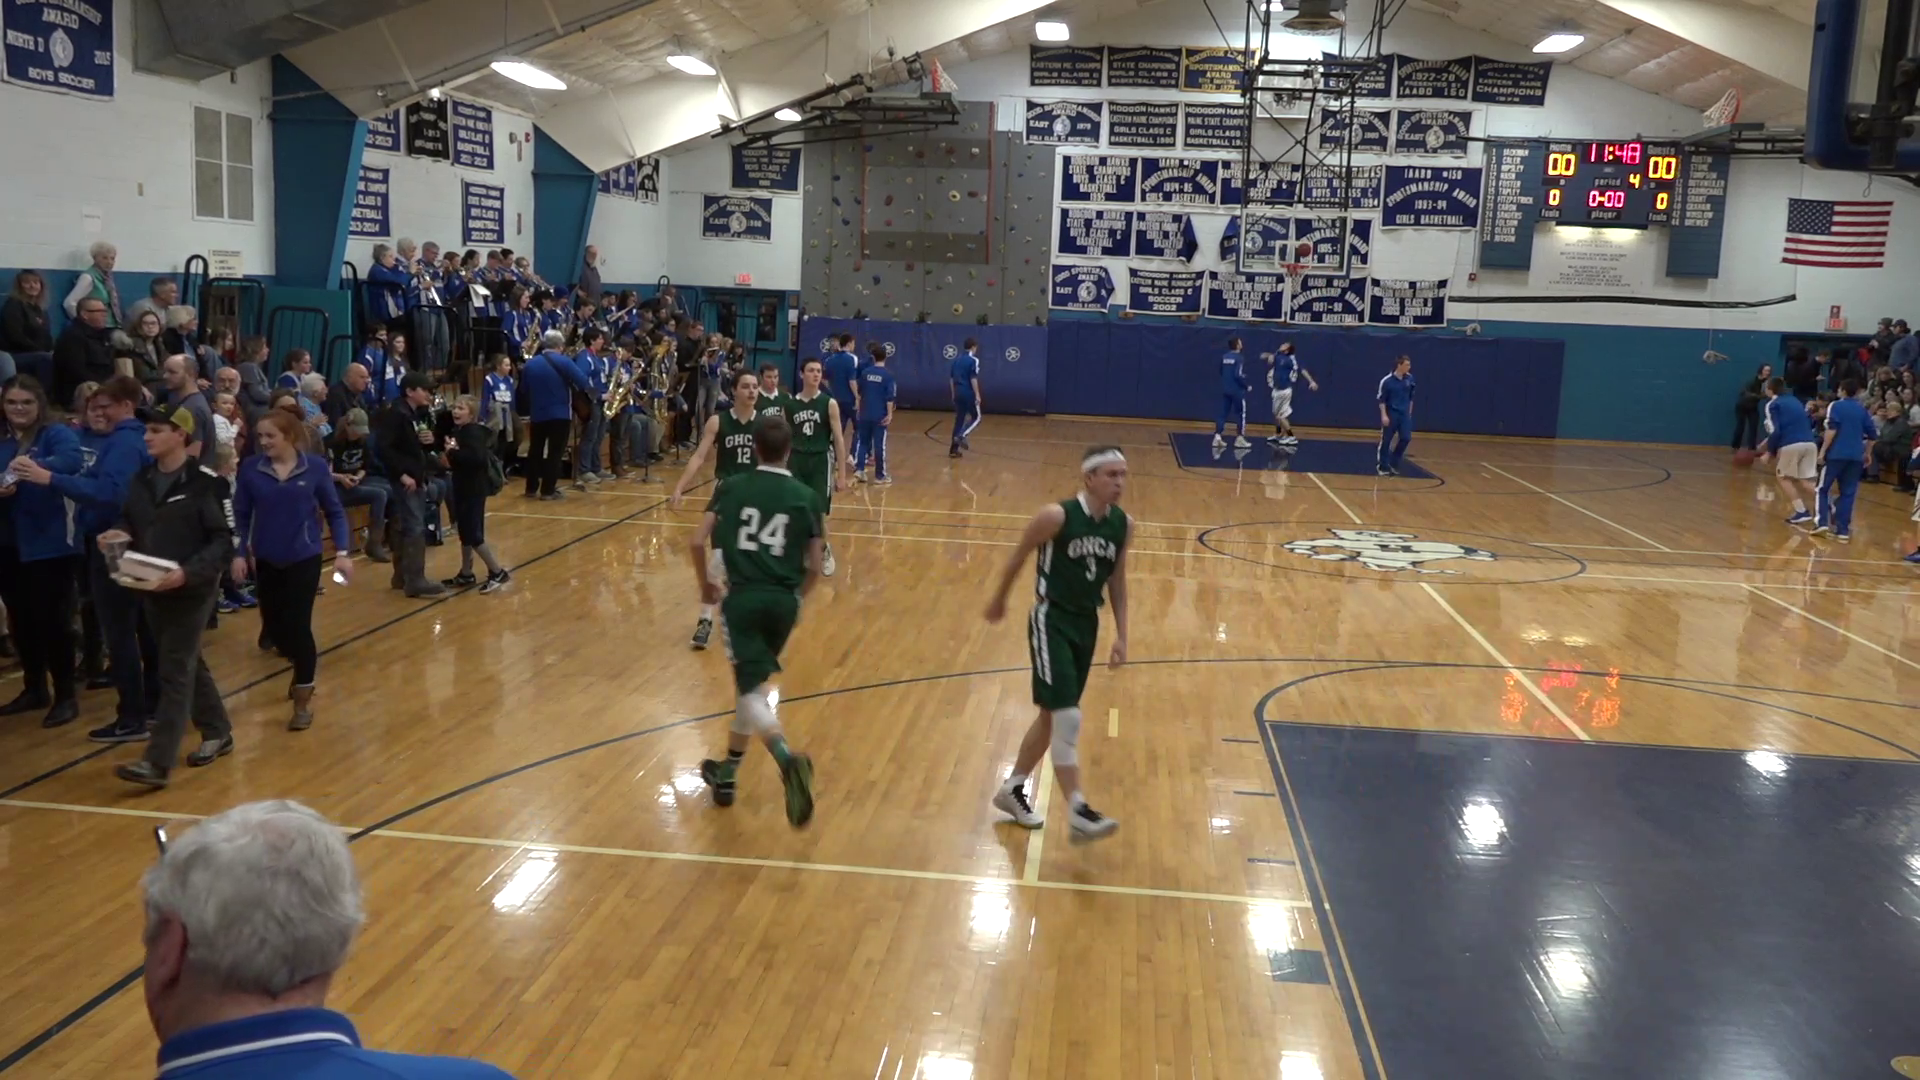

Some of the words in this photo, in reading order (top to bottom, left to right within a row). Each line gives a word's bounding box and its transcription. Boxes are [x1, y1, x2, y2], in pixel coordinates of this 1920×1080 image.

[42, 7, 79, 29] AWARD
[37, 37, 45, 53] D
[1399, 60, 1447, 78] SPORTSMANSHIP
[1450, 63, 1469, 81] AWARD
[28, 66, 54, 82] BOYS
[58, 72, 95, 90] SOCCER
[1478, 78, 1513, 86] EASTERN
[1444, 88, 1466, 96] 150
[1476, 85, 1543, 96] CHAMPIONS
[1148, 107, 1177, 115] HAWKS
[1186, 106, 1225, 114] HODGDON
[1029, 120, 1049, 128] EAST
[1189, 127, 1213, 136] GIRLS
[1215, 128, 1241, 137] CLASS
[1404, 130, 1424, 140] EAST
[1110, 136, 1154, 144] BASKETBALL
[1186, 137, 1230, 146] BASKETBALL
[1549, 143, 1573, 152] Home
[1647, 144, 1676, 156] Guests
[1589, 143, 1641, 164] 11:48
[1106, 157, 1129, 166] HAWKS
[1502, 156, 1521, 164] CALER
[1547, 153, 1577, 177] 00
[744, 163, 759, 171] BOYS
[1068, 165, 1086, 174] STATE
[1093, 166, 1131, 177] CHAMPIONS
[1648, 156, 1677, 179] 00
[748, 172, 781, 180] BASKETBALL
[1073, 174, 1089, 183] BOYS
[1095, 174, 1116, 184] CLASS
[1120, 175, 1126, 185] C
[1142, 167, 1195, 192] SPORTSMANSHIP
[1195, 173, 1216, 193] AWARD
[1629, 173, 1641, 189] 4
[1080, 183, 1117, 193] BASKETBALL
[1256, 179, 1277, 189] CLASS
[1499, 180, 1521, 188] FOSTER
[1594, 179, 1621, 188] period
[1312, 188, 1331, 197] BOYS
[1368, 189, 1373, 198] C
[1386, 181, 1449, 207] SPORTSMANSHIP
[1452, 188, 1478, 208] AWARD
[1687, 187, 1725, 196] CARMICHAEL
[358, 195, 376, 206] CLASS
[1145, 192, 1163, 202] GIRLS
[1171, 193, 1210, 204] BASKETBALL
[1497, 195, 1533, 204] FITZPATRICK
[1548, 188, 1561, 206] 0
[1588, 190, 1625, 208] 0-00
[1655, 192, 1669, 210] 0
[1687, 195, 1707, 203] GRANT
[1360, 198, 1378, 207] 1994
[726, 204, 750, 213] AWARD
[1541, 208, 1560, 218] fouls
[1396, 214, 1415, 224] GIRLS
[1421, 215, 1464, 225] BASKETBALL
[1496, 211, 1522, 219] SANDERS
[1591, 211, 1617, 221] player
[1648, 212, 1668, 222] fouls
[468, 219, 500, 230] BASKETBALL
[709, 217, 728, 225] EAST
[1066, 218, 1085, 227] STATE
[1092, 219, 1126, 230] CHAMPIONS
[1070, 228, 1086, 237] BOYS
[1090, 228, 1109, 238] CLASS
[1117, 230, 1121, 239] C
[1146, 230, 1163, 240] GIRLS
[1494, 226, 1515, 235] OLIVER
[1077, 237, 1113, 247] BASKETBALL
[1056, 286, 1073, 294] EAST
[1148, 296, 1183, 304] SOCCER
[1222, 290, 1240, 300] GIRLS
[1242, 291, 1262, 300] CLASS
[1264, 292, 1270, 302] C
[1290, 288, 1341, 310] SPORTSMANSHIP
[1344, 290, 1365, 312] AWARD
[1227, 300, 1264, 310] BASKETBALL
[1383, 298, 1400, 307] GIRLS
[1405, 298, 1423, 307] CLASS
[1381, 306, 1400, 316] CROSS
[1404, 307, 1432, 316] COUNTRY
[1295, 312, 1311, 322] BOYS
[1322, 314, 1359, 323] BASKETBALL
[793, 409, 821, 424] GHCA
[803, 420, 814, 436] 41
[725, 433, 756, 449] GHC
[737, 447, 750, 463] 12
[737, 506, 790, 557] 24
[1067, 535, 1117, 562] GHCA
